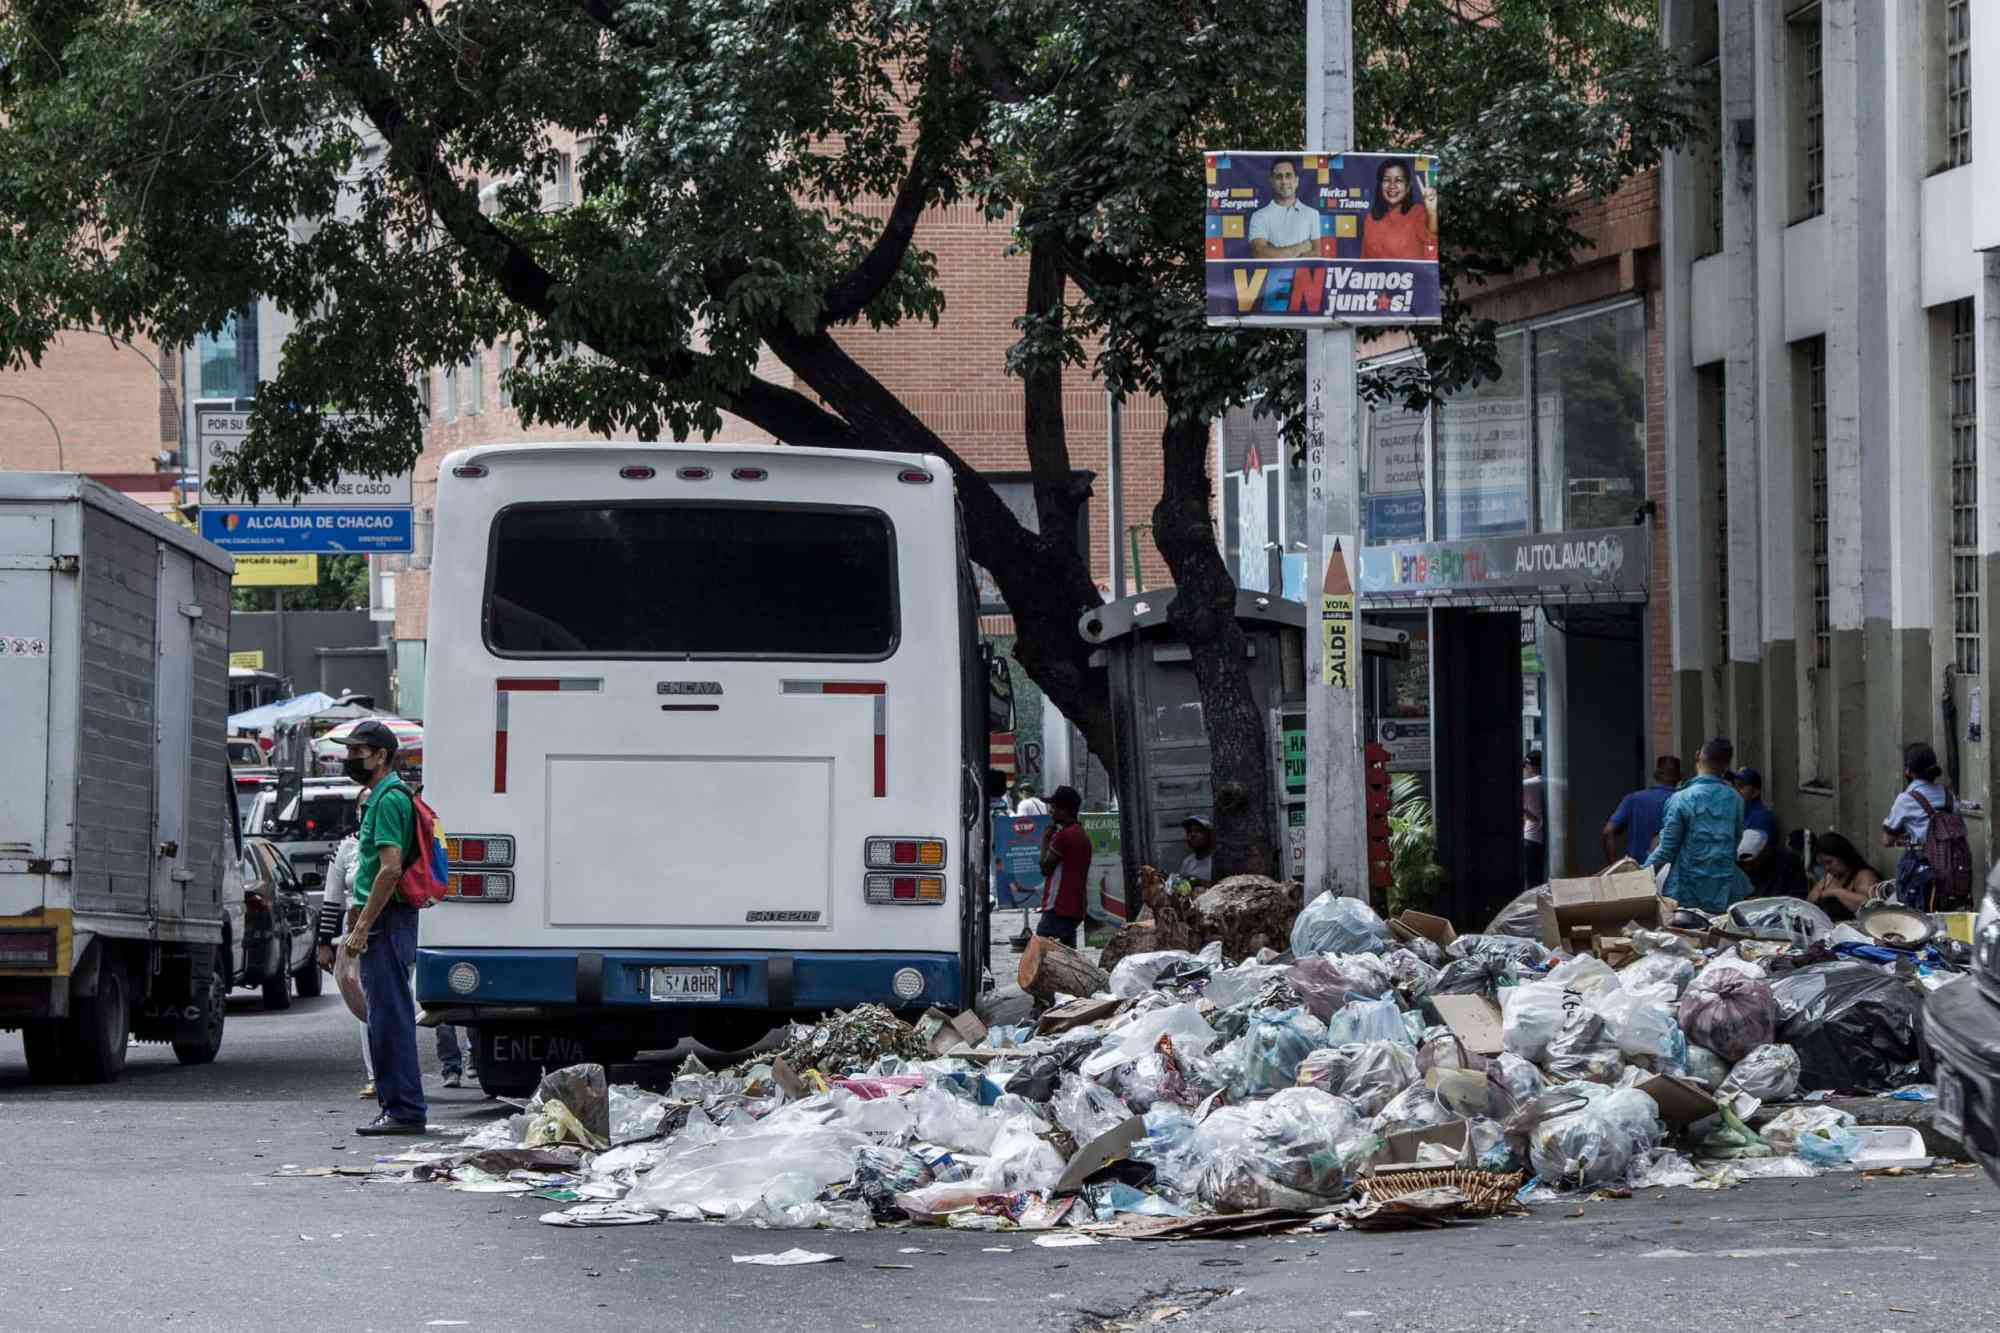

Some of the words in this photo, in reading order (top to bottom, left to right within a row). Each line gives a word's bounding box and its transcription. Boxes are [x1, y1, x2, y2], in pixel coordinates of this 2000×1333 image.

[1233, 266, 1327, 313] VEN
[207, 418, 229, 430] POR
[230, 418, 243, 430] SU
[355, 483, 392, 495] CASCO
[247, 516, 313, 528] ALCALDIA
[316, 516, 334, 528] DE
[336, 516, 393, 528] CHACAO
[1515, 540, 1609, 572] AUTOLAVADO
[1325, 600, 1350, 609] VOTA
[656, 681, 724, 695] ENCAVA
[494, 1035, 584, 1062] ENCAVA
